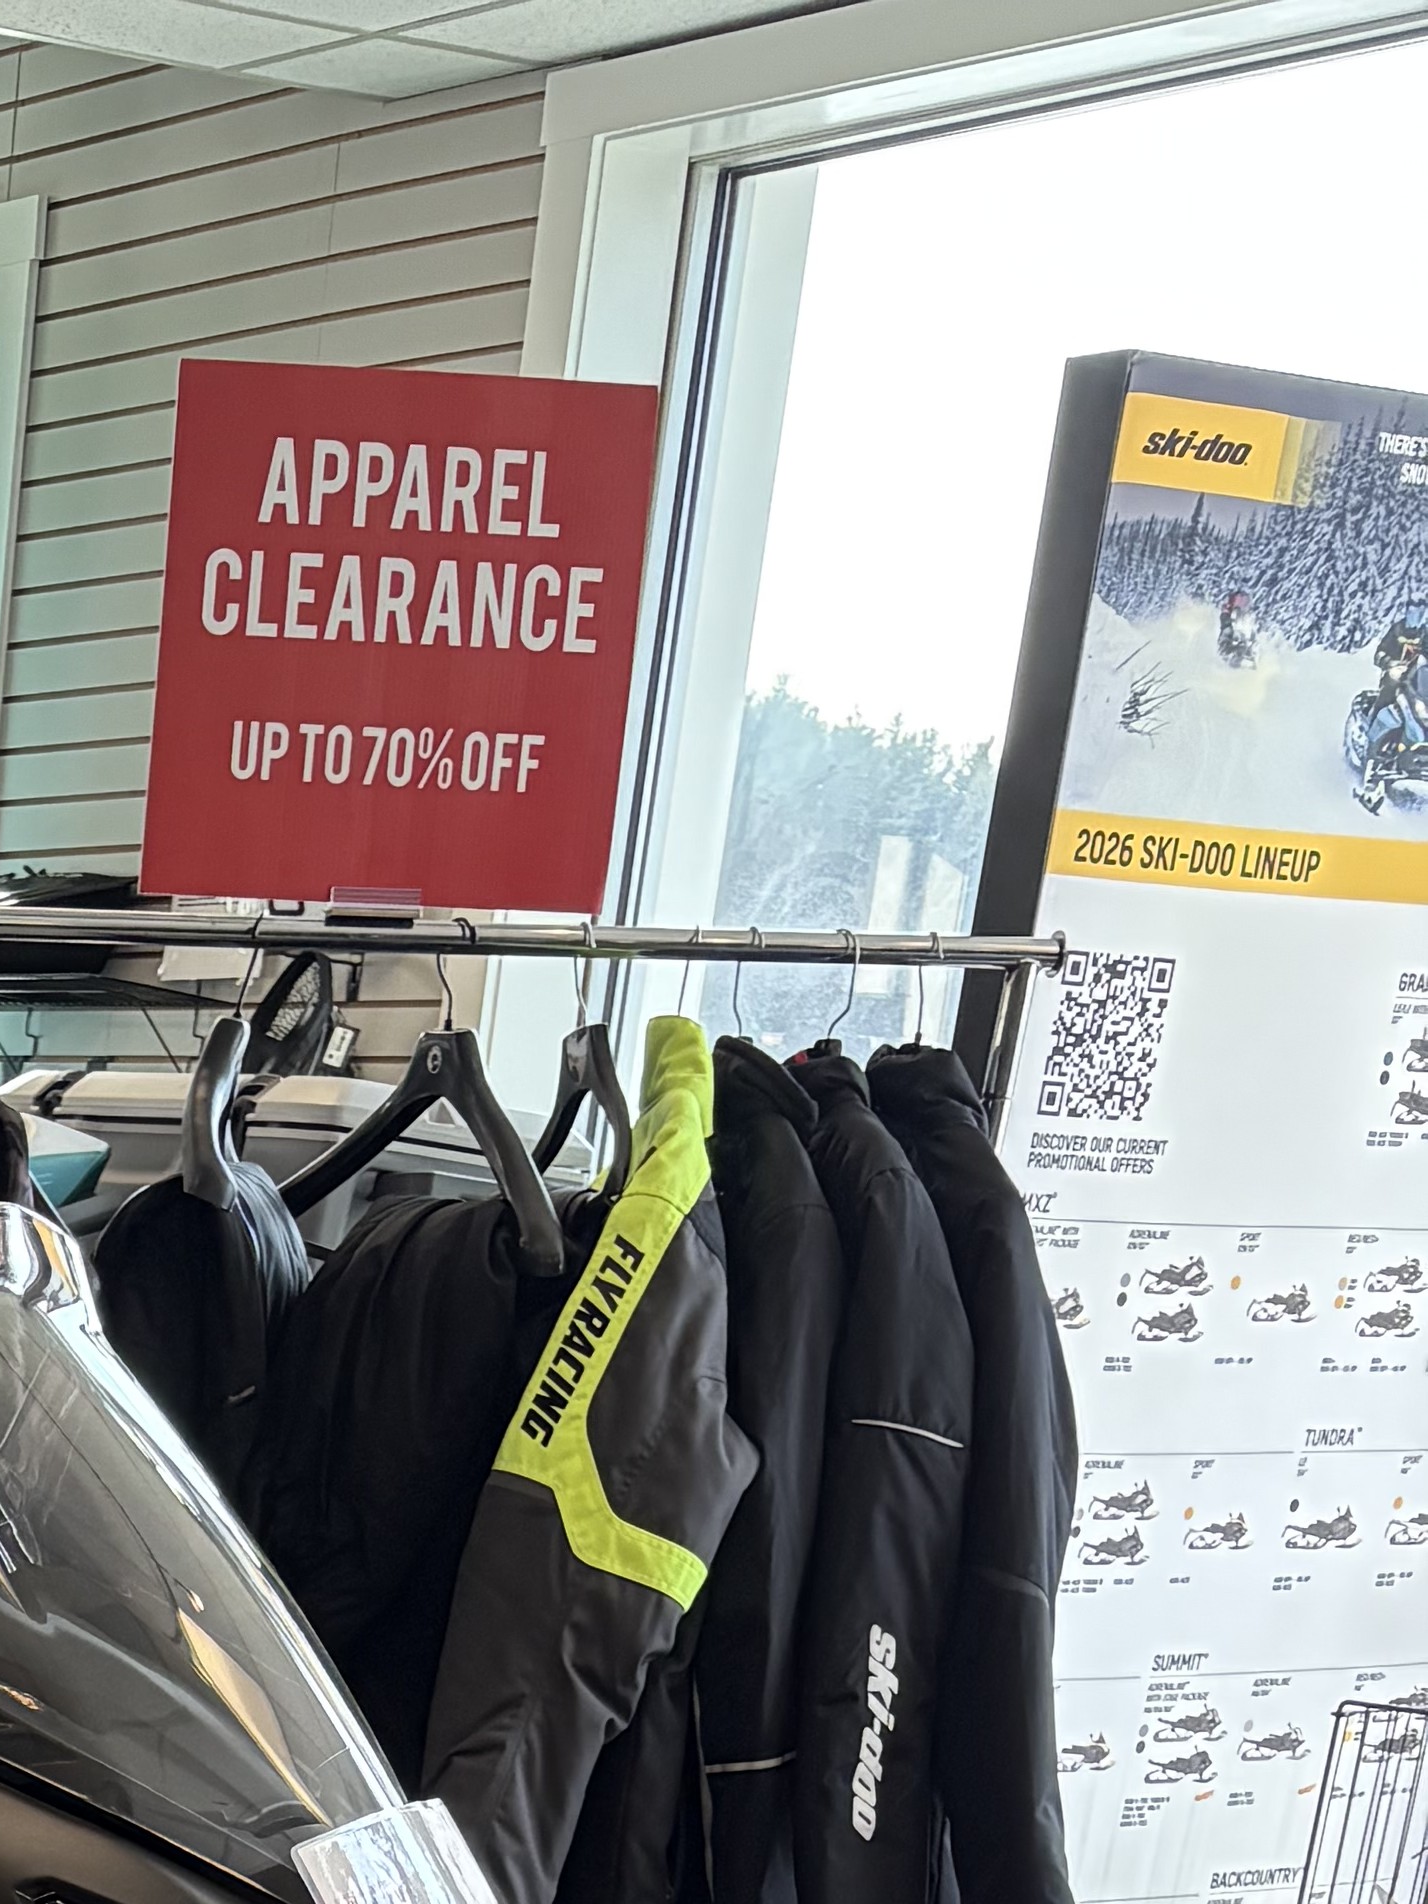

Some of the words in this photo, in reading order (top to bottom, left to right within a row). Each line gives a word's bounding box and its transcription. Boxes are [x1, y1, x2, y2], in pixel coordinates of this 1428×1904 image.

[1142, 428, 1252, 466] ski-doo
[258, 437, 560, 539] APPAREL
[1400, 462, 1428, 485] SNO
[201, 548, 604, 654] CLEARANCE
[230, 721, 290, 781] UP
[299, 724, 353, 784] TO
[362, 727, 454, 790] 70%
[460, 731, 546, 793] OFF
[1074, 829, 1134, 867] 2026
[1140, 835, 1235, 876] SKI-DOO
[1240, 844, 1321, 882] LINEUP
[1398, 973, 1428, 992] GRA
[1027, 1152, 1107, 1172] PROMOTIONAL
[1110, 1157, 1155, 1174] OFFERS
[1030, 1132, 1088, 1152] DISCOVER
[1090, 1136, 1113, 1153] OUR
[1116, 1138, 1169, 1156] CURRENT
[591, 1233, 646, 1314] FLY
[520, 1297, 611, 1448] RACING
[1305, 1428, 1354, 1447] TUNDRA
[1152, 1653, 1204, 1672] SUMMIT
[852, 1622, 898, 1843] ski-doo
[1210, 1867, 1301, 1889] BACKCOUNTRY
